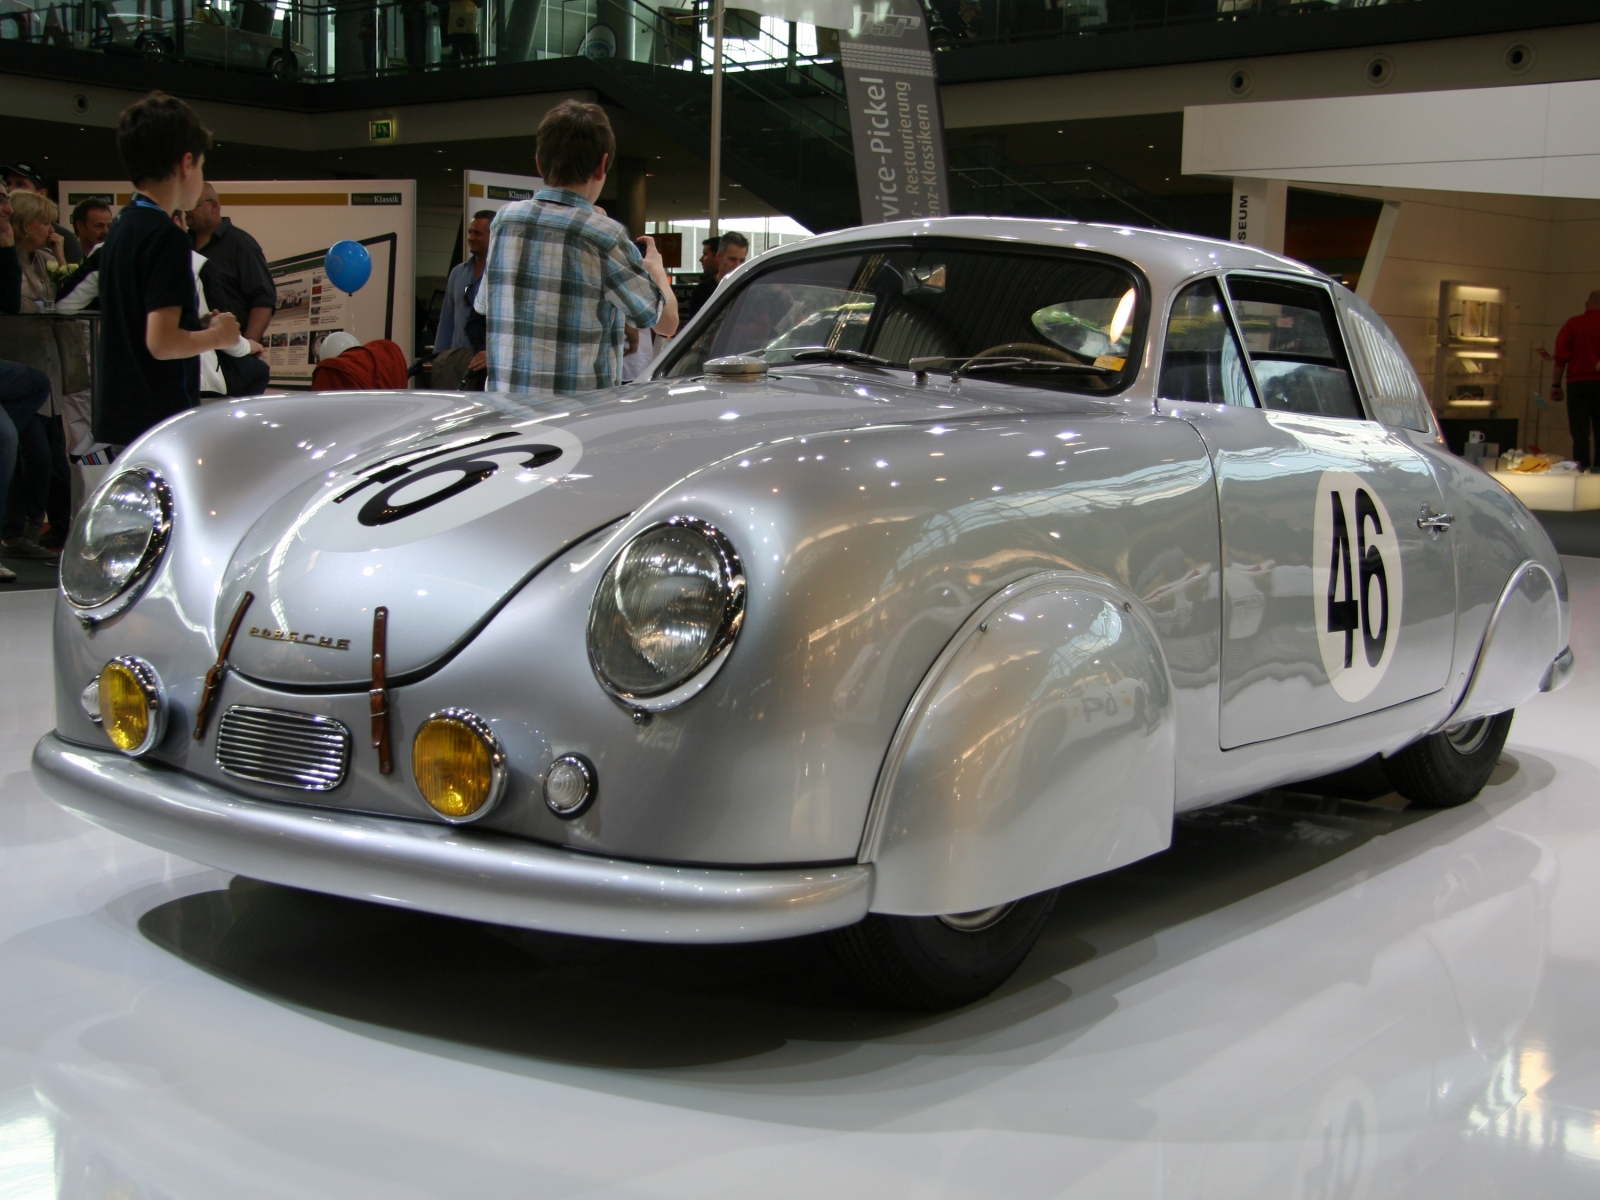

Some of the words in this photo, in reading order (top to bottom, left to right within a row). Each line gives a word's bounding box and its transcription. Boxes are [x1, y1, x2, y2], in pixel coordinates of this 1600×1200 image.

[895, 81, 920, 194] Restaurierung
[331, 431, 564, 527] 46
[1327, 487, 1389, 669] 46
[248, 626, 351, 651] PORSCHE
